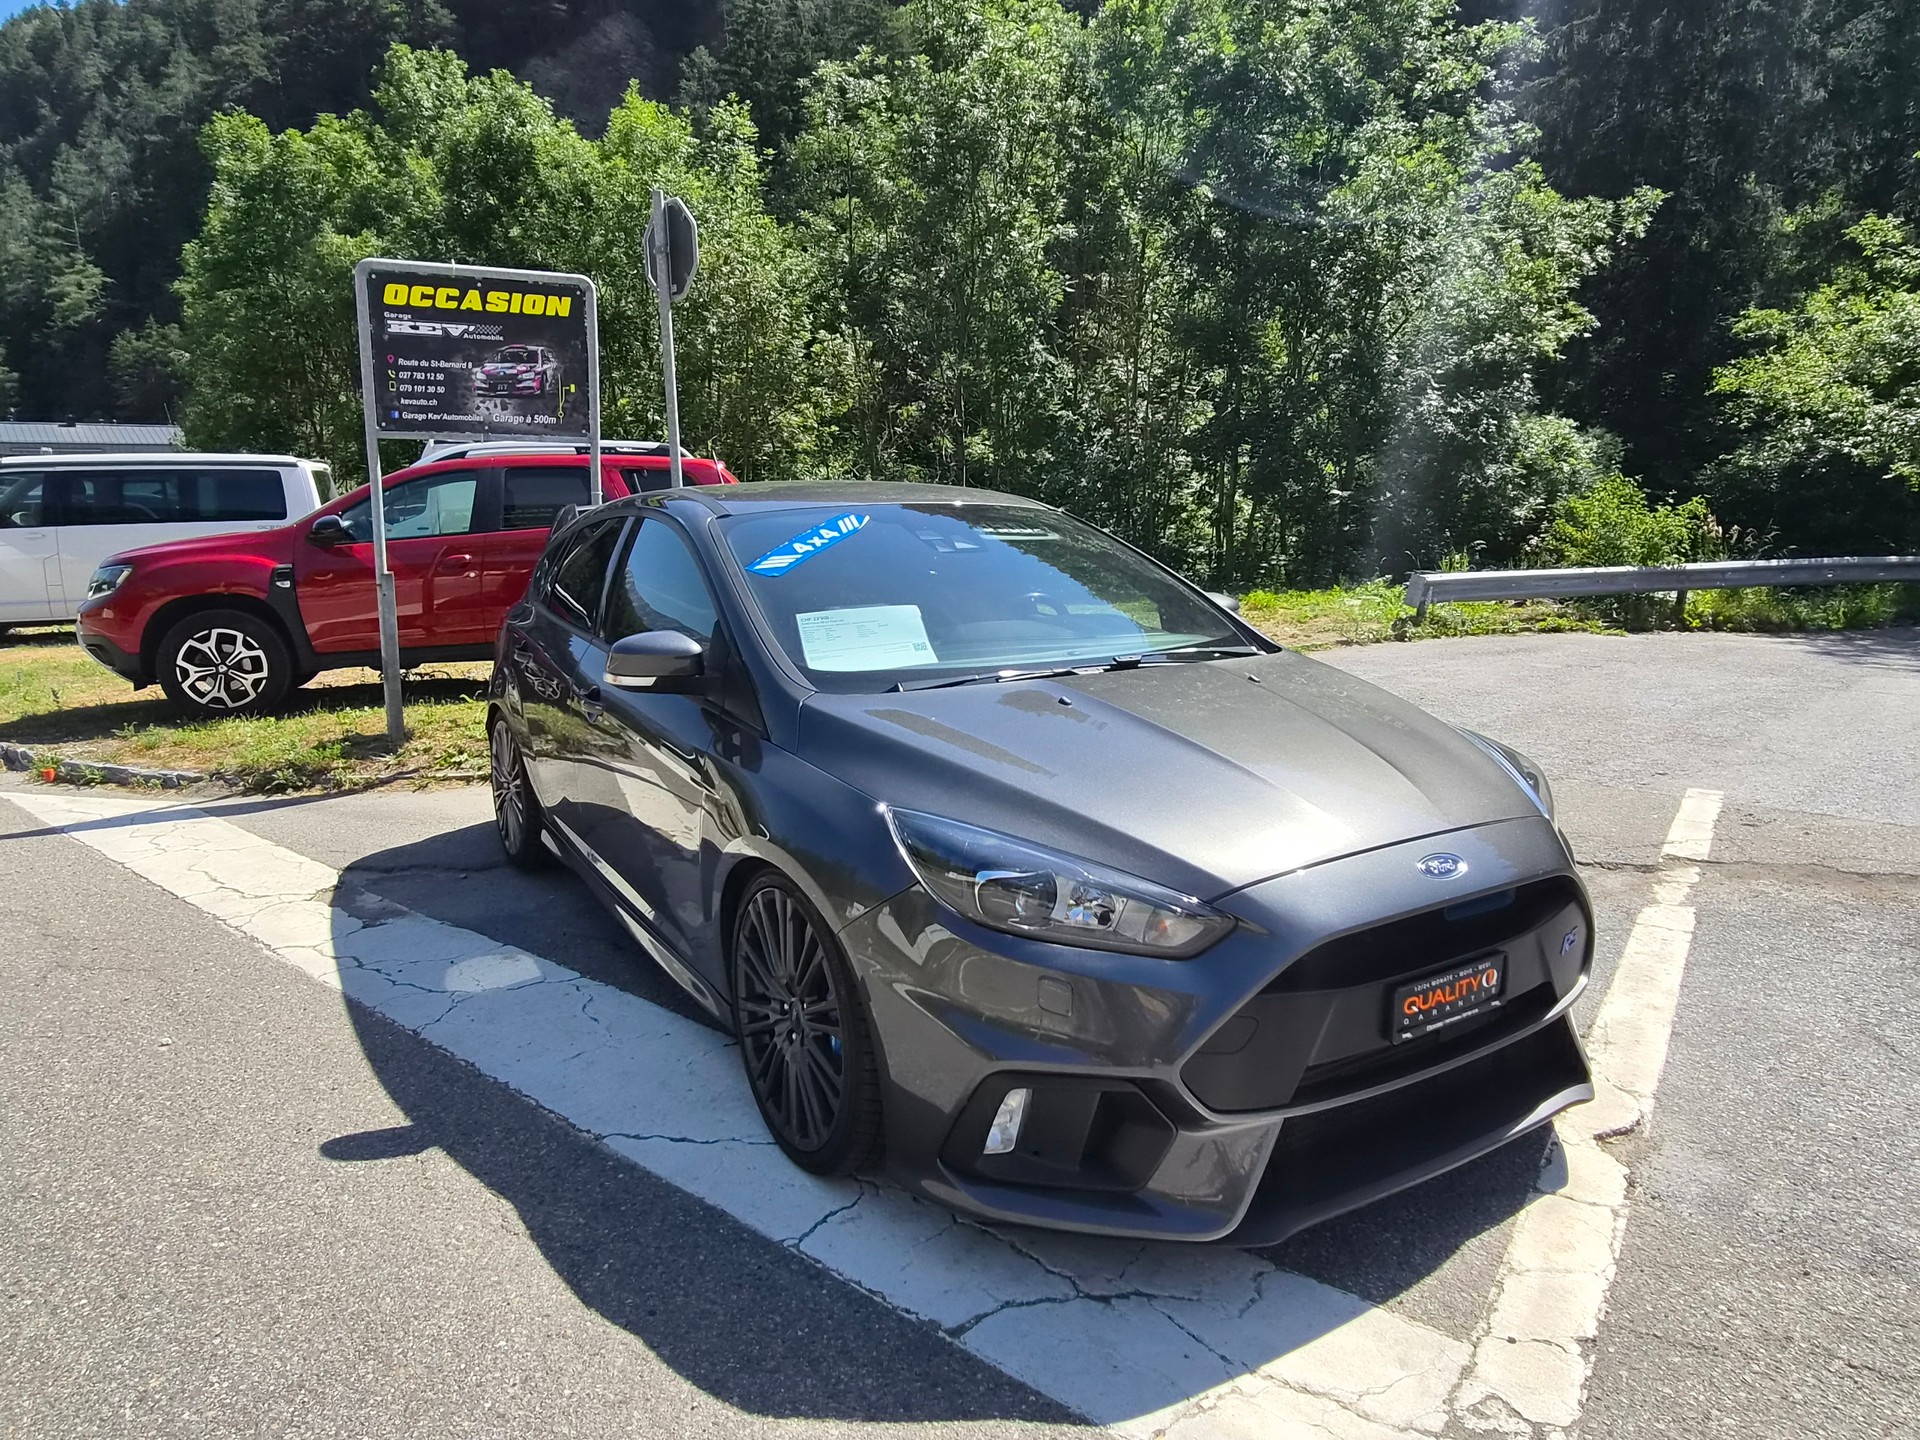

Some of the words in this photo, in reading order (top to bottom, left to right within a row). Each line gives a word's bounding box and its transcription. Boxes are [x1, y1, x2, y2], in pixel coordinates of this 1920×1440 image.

[383, 283, 572, 317] OCCASION
[384, 311, 412, 320] Garage
[463, 333, 504, 341] Automobile
[398, 358, 419, 367] Route
[420, 359, 429, 367] du
[430, 359, 467, 369] St-Bernard
[398, 371, 412, 379] 027
[413, 372, 425, 380] 783
[426, 372, 435, 380] 12
[436, 373, 445, 381] 50
[399, 384, 412, 392] 079
[426, 385, 436, 393] 30
[400, 397, 438, 406] kevauto.ch
[402, 412, 427, 421] Garage
[493, 413, 524, 425] Garage
[525, 414, 532, 423] à
[533, 414, 557, 424] 500m
[1428, 859, 1456, 873] Ford
